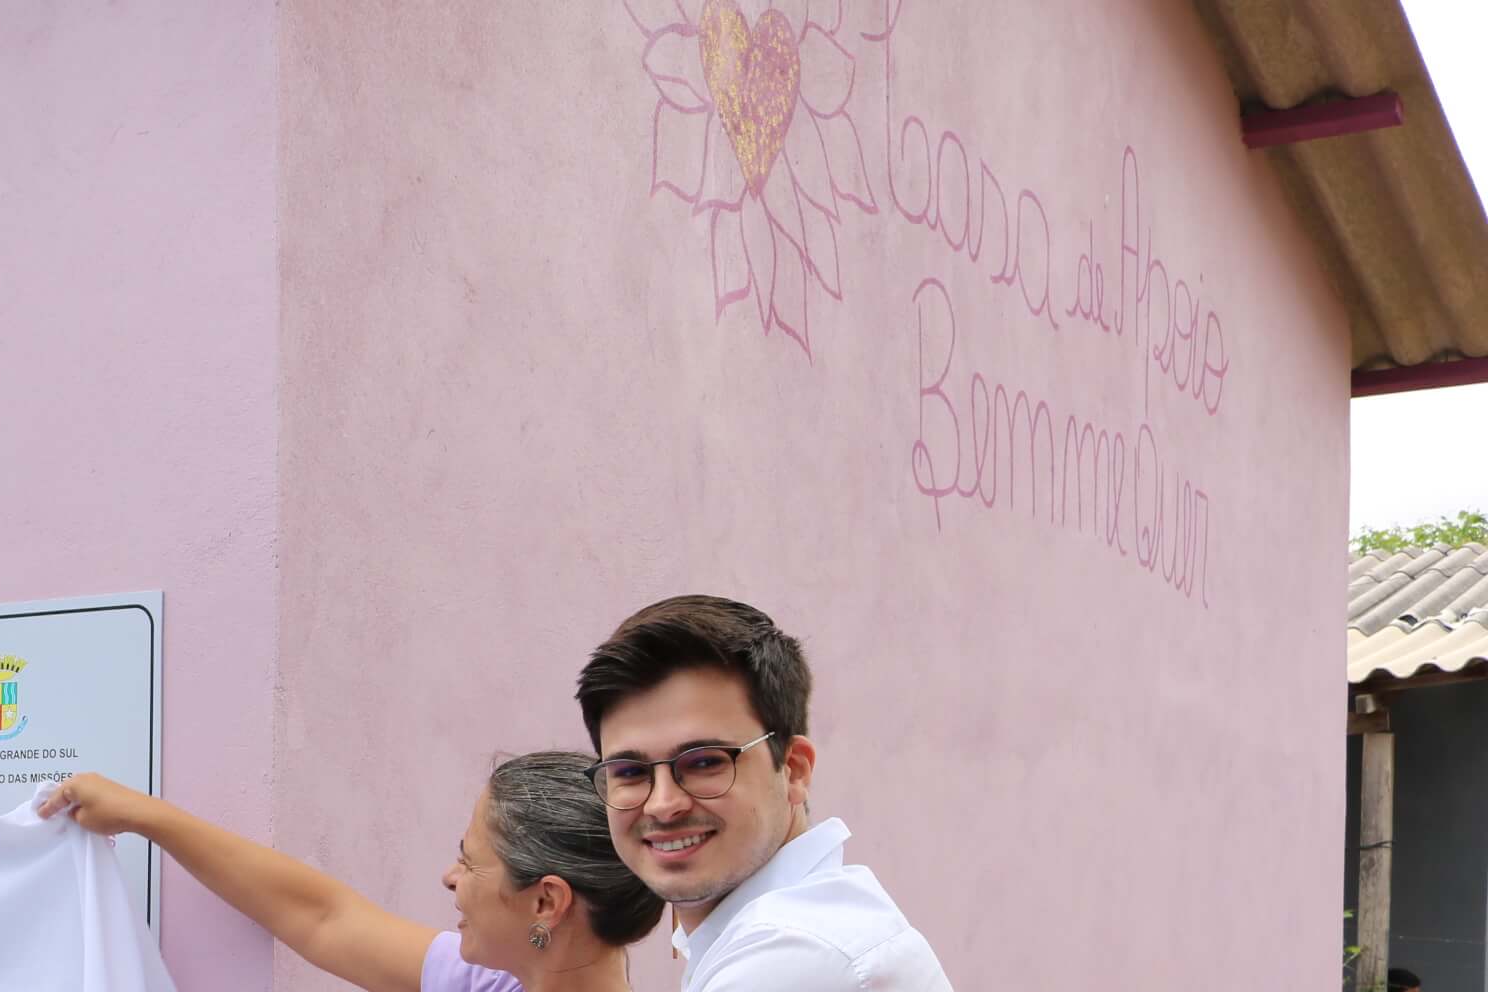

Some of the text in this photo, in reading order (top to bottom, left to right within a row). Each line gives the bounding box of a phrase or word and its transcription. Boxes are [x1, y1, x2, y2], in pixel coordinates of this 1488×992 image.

[860, 0, 1230, 416] Casa de Apoio
[0, 749, 40, 760] GRANDE
[42, 748, 57, 759] DO
[59, 747, 79, 759] SUL
[7, 773, 28, 784] DAS
